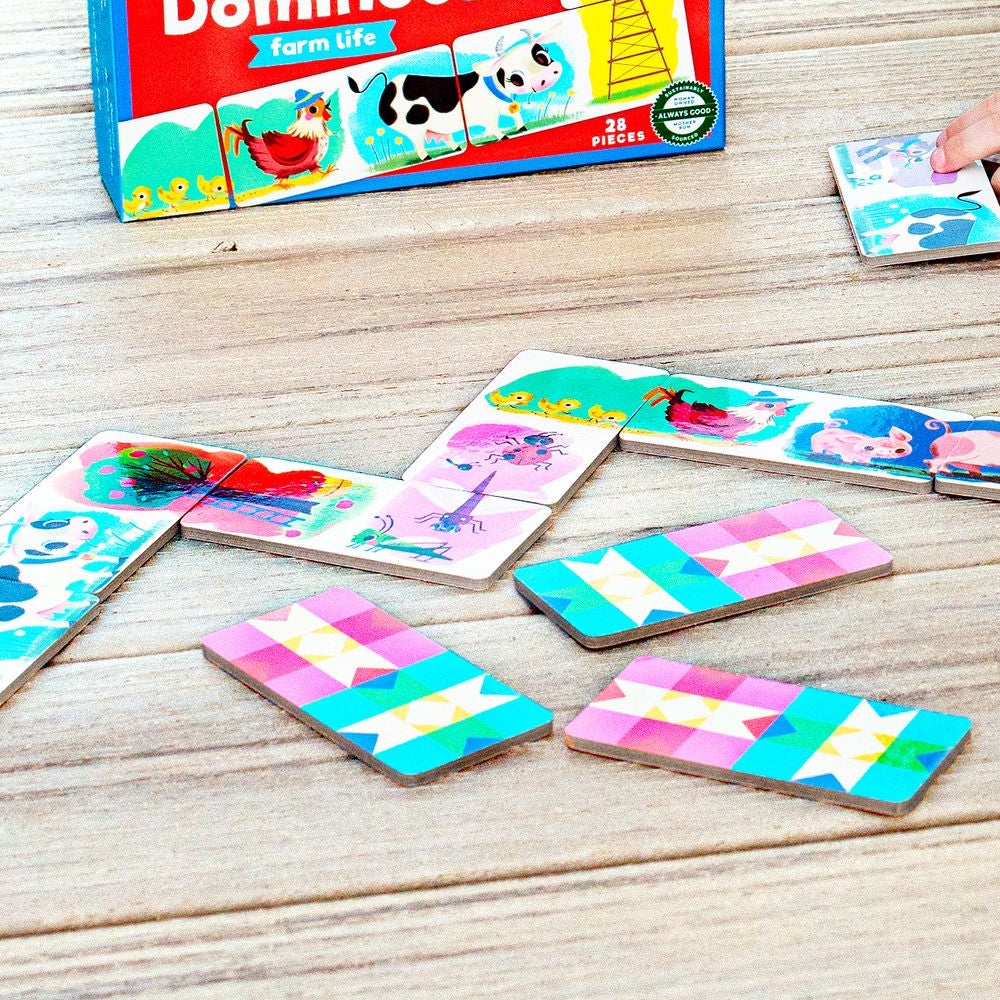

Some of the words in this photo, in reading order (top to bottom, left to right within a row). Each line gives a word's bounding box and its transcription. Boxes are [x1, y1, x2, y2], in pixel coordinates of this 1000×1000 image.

[269, 35, 329, 57] farm
[335, 27, 377, 52] life
[664, 85, 705, 98] SUSTAINABLY
[658, 110, 689, 119] ALWAYS
[689, 107, 711, 116] GOOD
[605, 118, 627, 133] 28
[592, 131, 645, 147] PIECES
[671, 132, 699, 142] SOURCED
